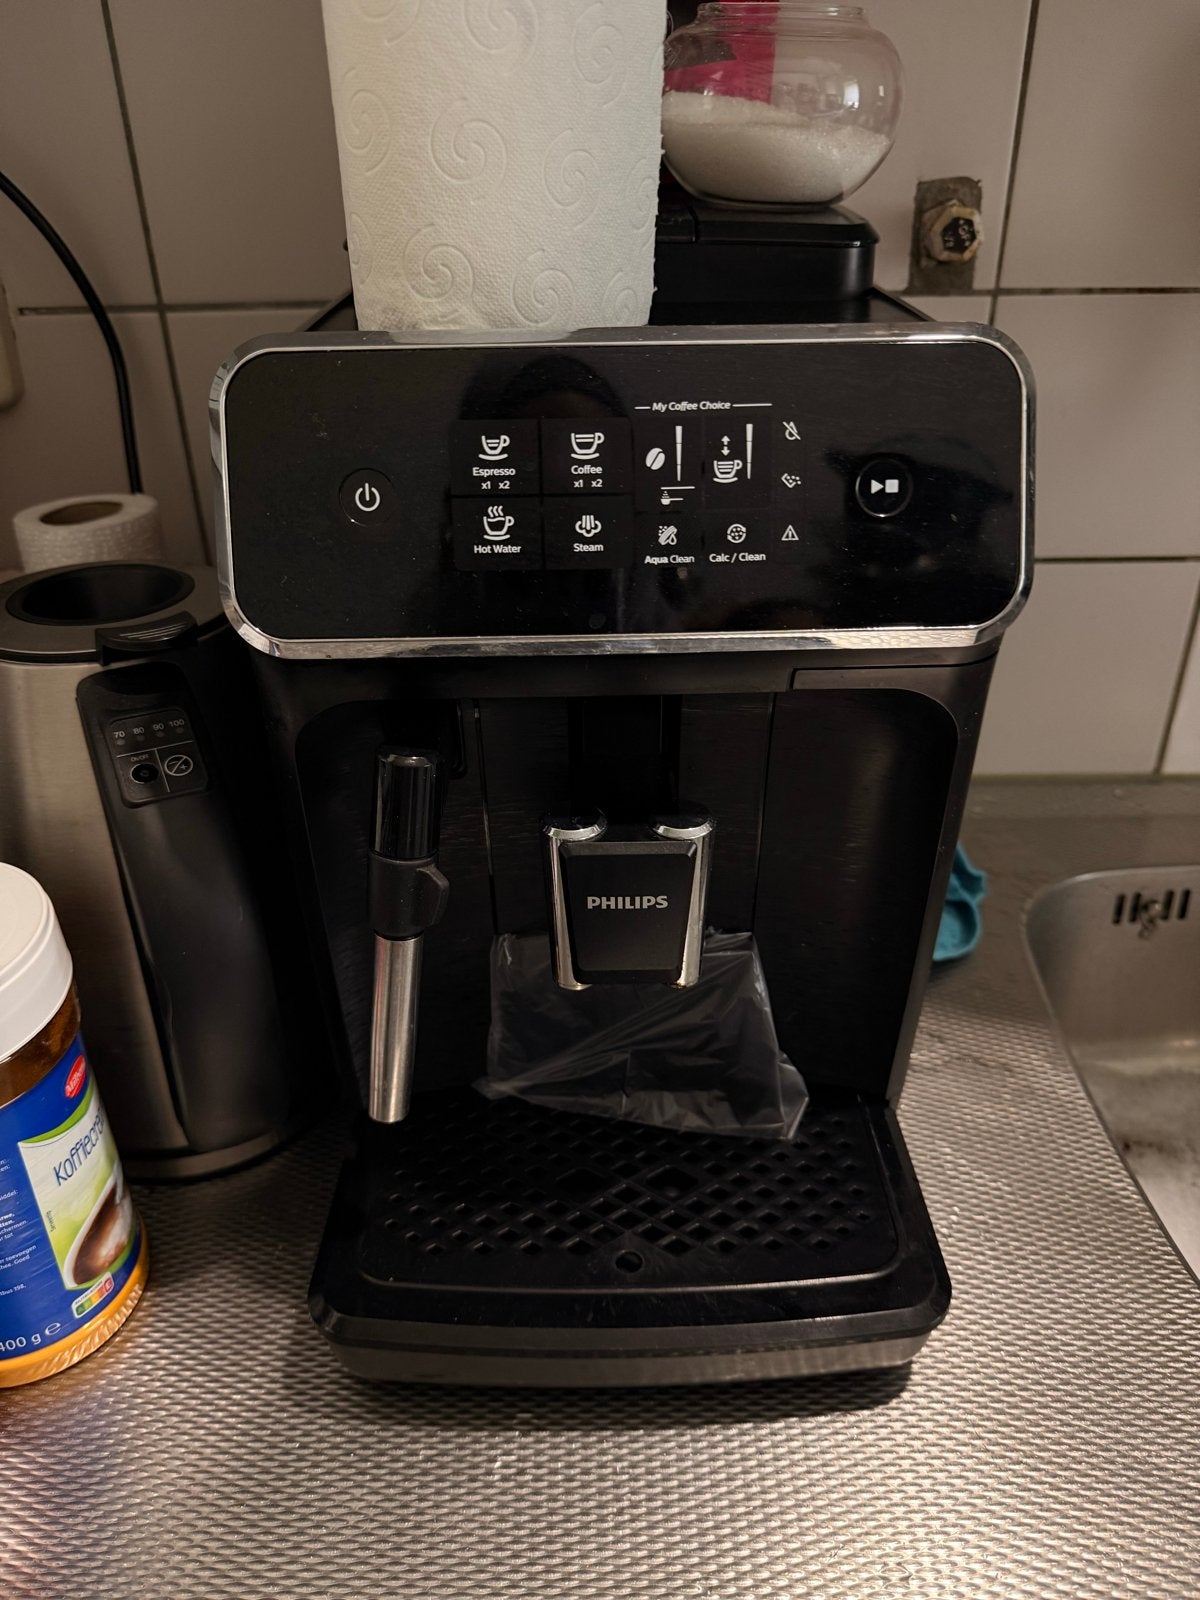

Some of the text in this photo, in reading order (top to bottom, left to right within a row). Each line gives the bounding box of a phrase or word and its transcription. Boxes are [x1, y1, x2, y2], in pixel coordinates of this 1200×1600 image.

[652, 400, 731, 413] My Coffee Choice
[472, 467, 516, 477] Espresso
[571, 465, 603, 474] Coffee
[481, 480, 510, 490] x1 x2
[573, 479, 603, 488] x1 x2
[473, 544, 521, 554] Hot Water
[573, 543, 604, 552] Steam
[644, 555, 695, 565] Aqua Clean
[709, 553, 730, 562] Calc
[738, 552, 766, 562] Clean
[114, 718, 185, 739] 70 80 90 100
[587, 895, 669, 910] PHILIPS
